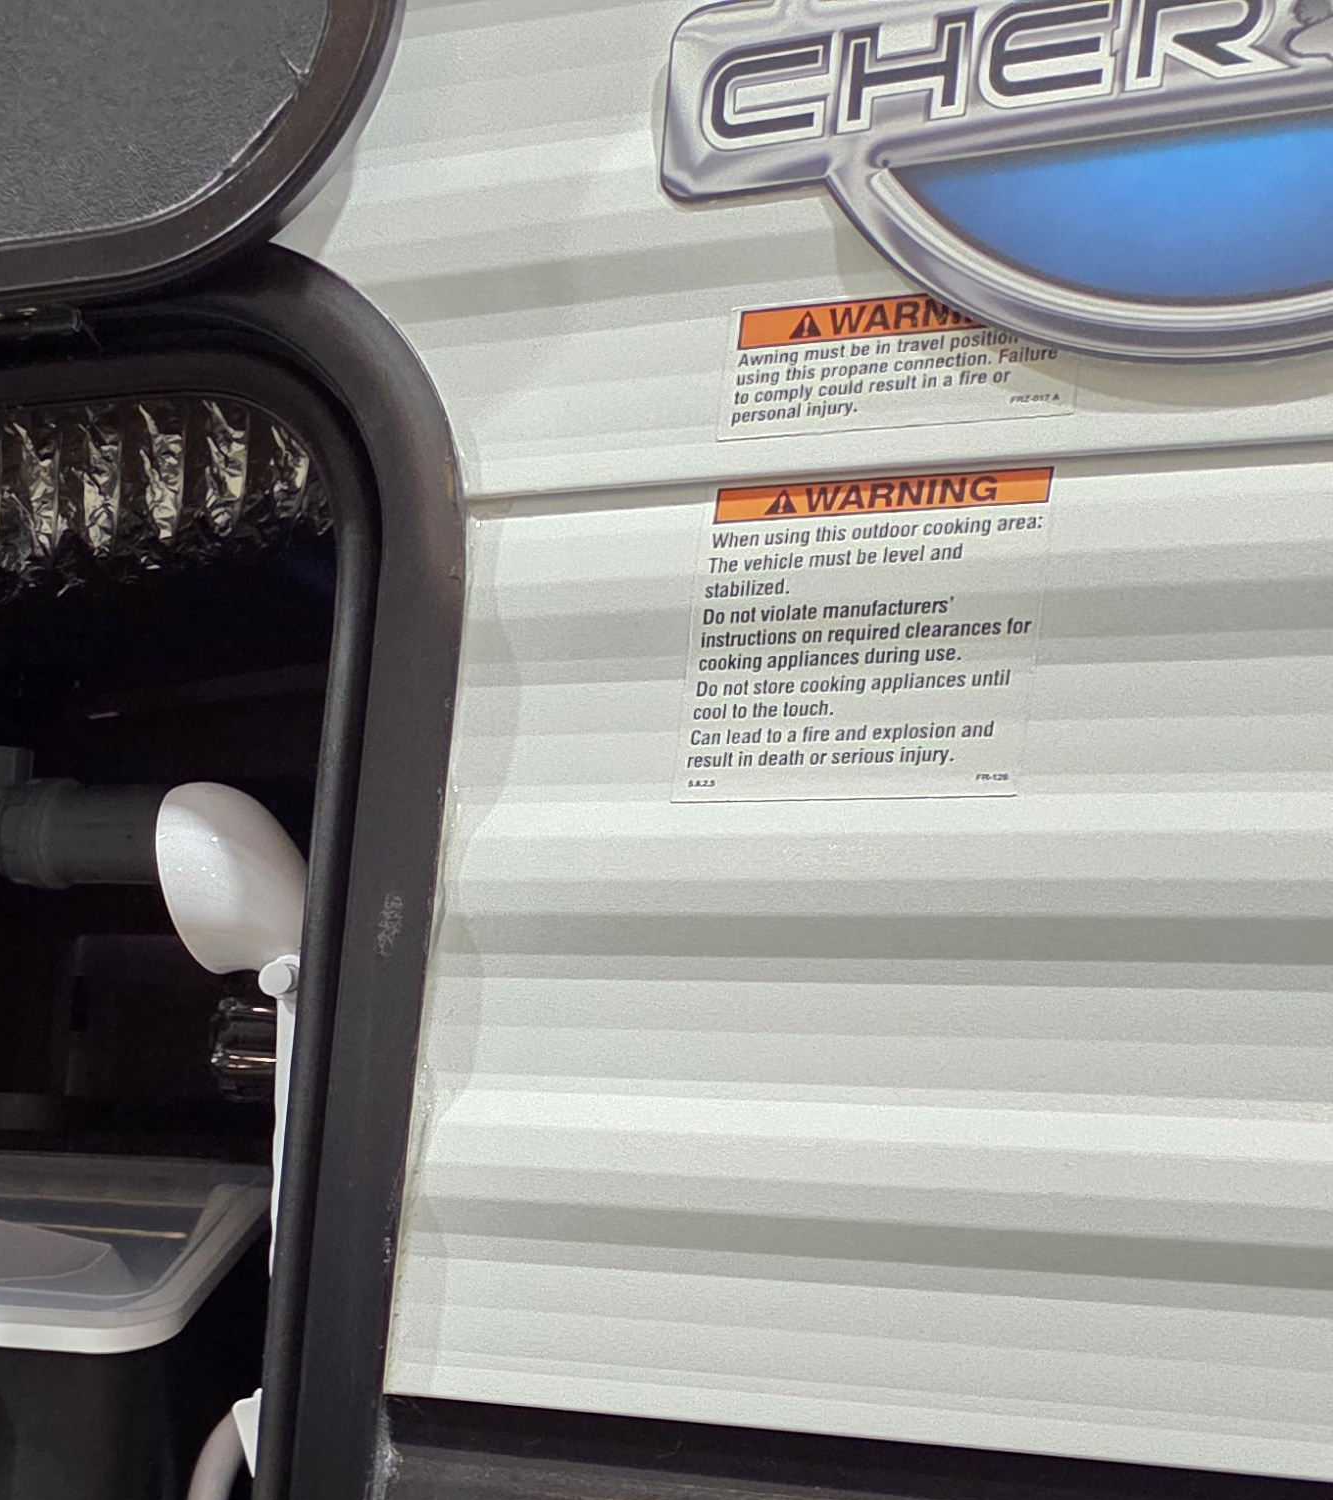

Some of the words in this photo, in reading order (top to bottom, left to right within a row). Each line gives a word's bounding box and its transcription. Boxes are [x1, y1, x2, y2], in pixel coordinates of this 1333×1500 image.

[829, 300, 976, 335] WARN
[736, 369, 780, 386] using
[786, 365, 815, 381] this
[820, 362, 888, 381] propane
[894, 352, 991, 372] connection.
[998, 347, 1058, 364] Failure
[738, 352, 798, 367] Awning
[804, 345, 845, 361] must
[850, 344, 870, 357] be
[876, 343, 890, 354] in
[897, 336, 944, 353] travel
[734, 391, 749, 405] to
[754, 384, 813, 405] comply
[818, 380, 863, 397] could
[868, 375, 917, 393] result
[922, 373, 937, 388] in
[943, 376, 952, 387] a
[959, 370, 987, 385] fire
[993, 371, 1011, 383] or
[730, 408, 801, 427] personal
[806, 400, 858, 419] injury.
[804, 475, 998, 514] WARNING
[713, 532, 759, 549] When
[764, 528, 810, 547] using
[816, 525, 847, 542] this
[852, 522, 919, 540] outdoor
[923, 517, 992, 536] cooking
[997, 516, 1043, 531] area:
[708, 557, 738, 574] The
[744, 552, 803, 571] vehicle
[809, 550, 851, 568] must
[856, 548, 877, 565] be
[883, 545, 925, 563] level
[930, 543, 963, 561] and
[705, 578, 790, 599] stabilized.
[703, 609, 725, 625] Do
[730, 607, 756, 624] not
[761, 604, 817, 622] violate
[823, 596, 954, 619] manufacturers'
[701, 629, 797, 648] instructions
[802, 630, 822, 644] on
[827, 622, 900, 645] required
[905, 621, 1002, 639] clearances
[1007, 617, 1032, 634] for
[699, 653, 762, 672] cooking
[767, 650, 860, 672] appliances
[864, 646, 920, 666] during
[925, 648, 961, 662] use.
[696, 681, 718, 697] Do
[723, 680, 749, 696] not
[753, 679, 794, 695] store
[800, 675, 866, 695] cooking
[871, 672, 966, 694] appliances
[972, 669, 1011, 687] until
[693, 703, 727, 720] cool
[732, 703, 747, 719] to
[752, 702, 778, 718] the
[783, 700, 834, 717] touch.
[690, 730, 721, 745] Can
[726, 728, 762, 744] lead
[767, 728, 782, 743] to
[787, 730, 797, 743] a
[802, 726, 830, 742] fire
[835, 725, 867, 741] and
[872, 722, 956, 743] explosion
[961, 720, 995, 738] and
[687, 752, 733, 768] result
[738, 751, 753, 767] in
[758, 750, 804, 766] death
[810, 753, 828, 765] or
[831, 748, 894, 764] serious
[899, 745, 955, 766] injury.
